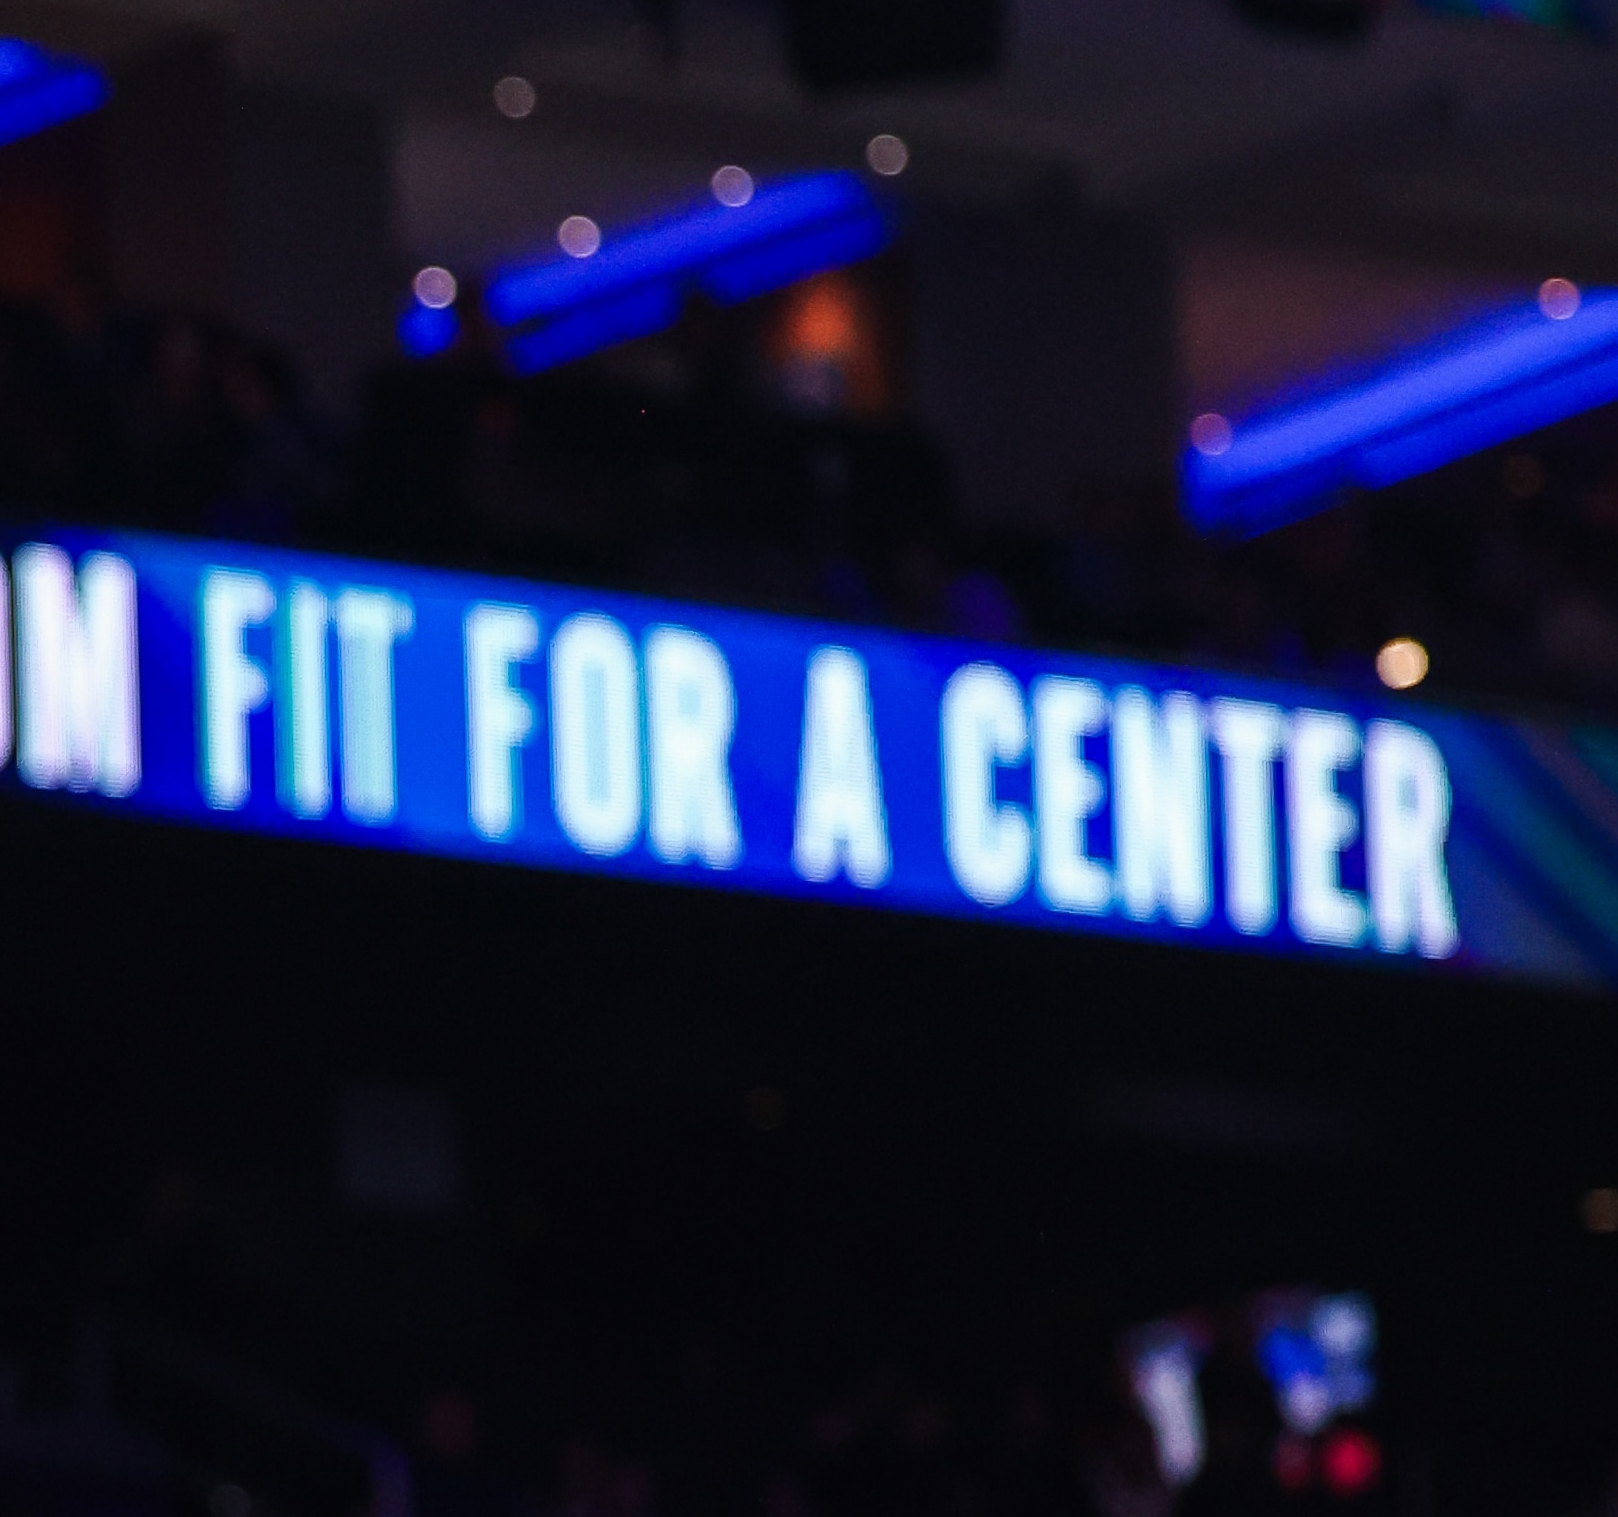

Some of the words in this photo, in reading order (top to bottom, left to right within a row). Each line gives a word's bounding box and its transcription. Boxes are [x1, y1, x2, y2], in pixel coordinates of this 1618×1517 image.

[198, 562, 413, 824] FIT
[464, 599, 743, 872] FOR
[792, 644, 892, 889] A
[939, 660, 1460, 960] CENTER
